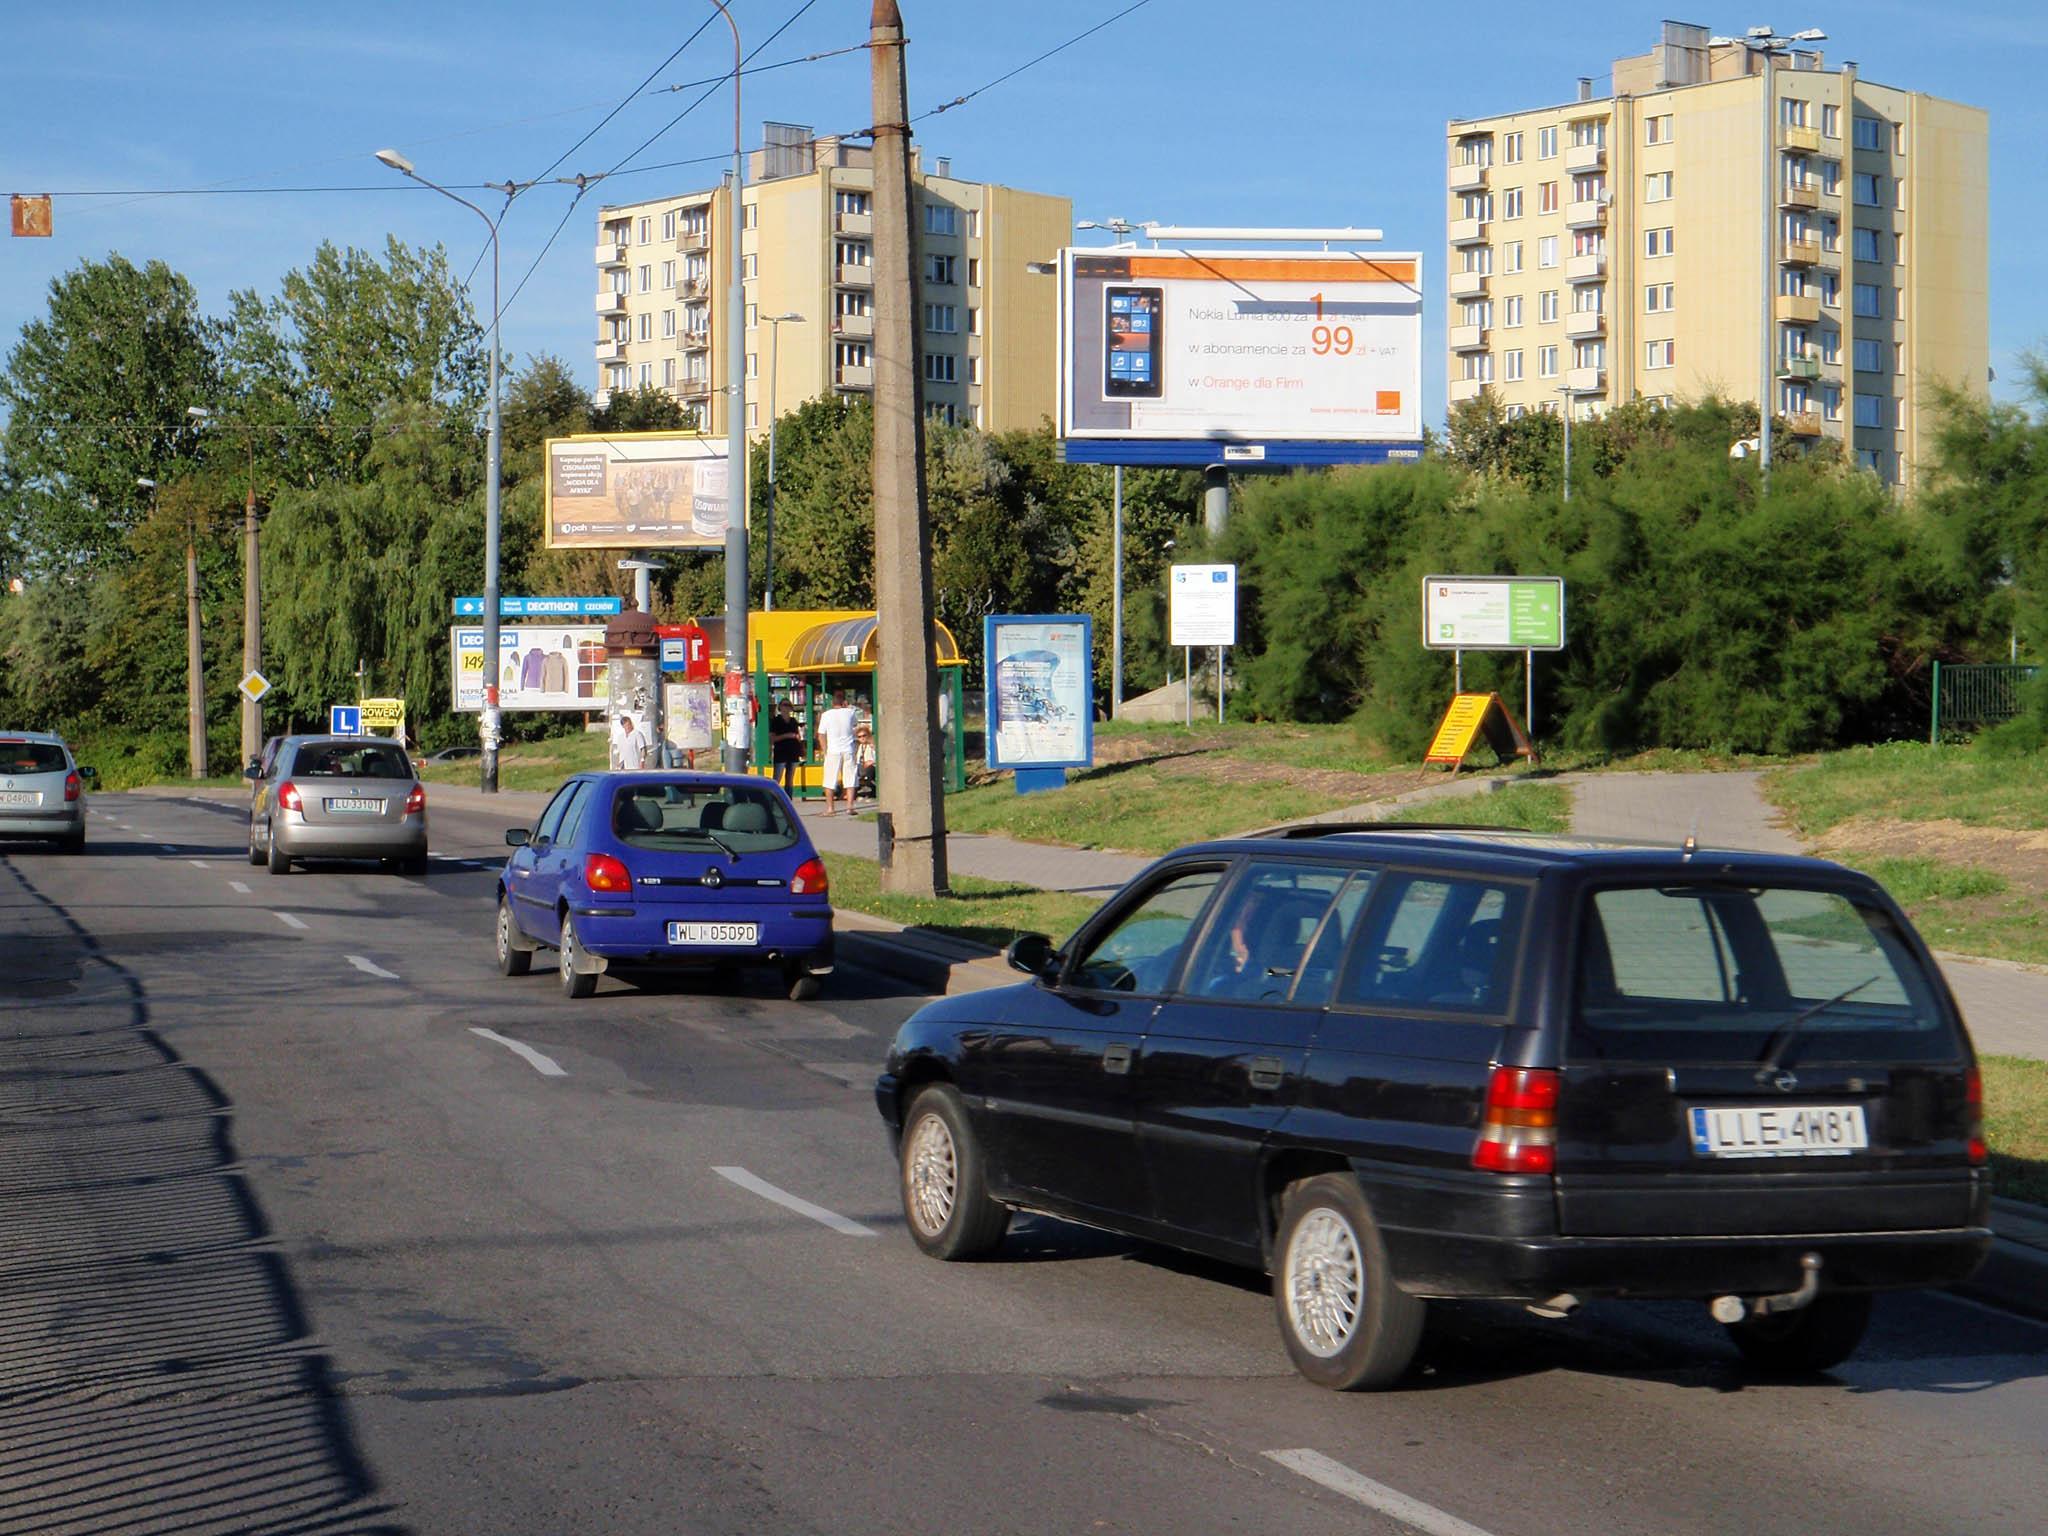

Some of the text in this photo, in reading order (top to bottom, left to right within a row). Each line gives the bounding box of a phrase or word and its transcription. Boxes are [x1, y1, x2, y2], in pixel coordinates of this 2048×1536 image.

[1188, 308, 1224, 320] Nokia
[1227, 308, 1263, 320] Lumia
[1266, 310, 1291, 321] 800
[1294, 311, 1308, 321] za
[1310, 292, 1323, 321] 1
[1188, 345, 1200, 353] w
[1203, 343, 1288, 354] abonamencie
[1291, 346, 1306, 355] za
[1311, 325, 1354, 356] 99
[1188, 376, 1304, 391] w Orange dla Firm
[527, 601, 578, 611] DECATHLON
[462, 635, 516, 646] DECON
[341, 711, 354, 730] L
[361, 708, 401, 718] ROWERY
[335, 799, 349, 809] LU
[678, 925, 755, 941] WLI 05090
[1715, 1112, 1780, 1147] LLE
